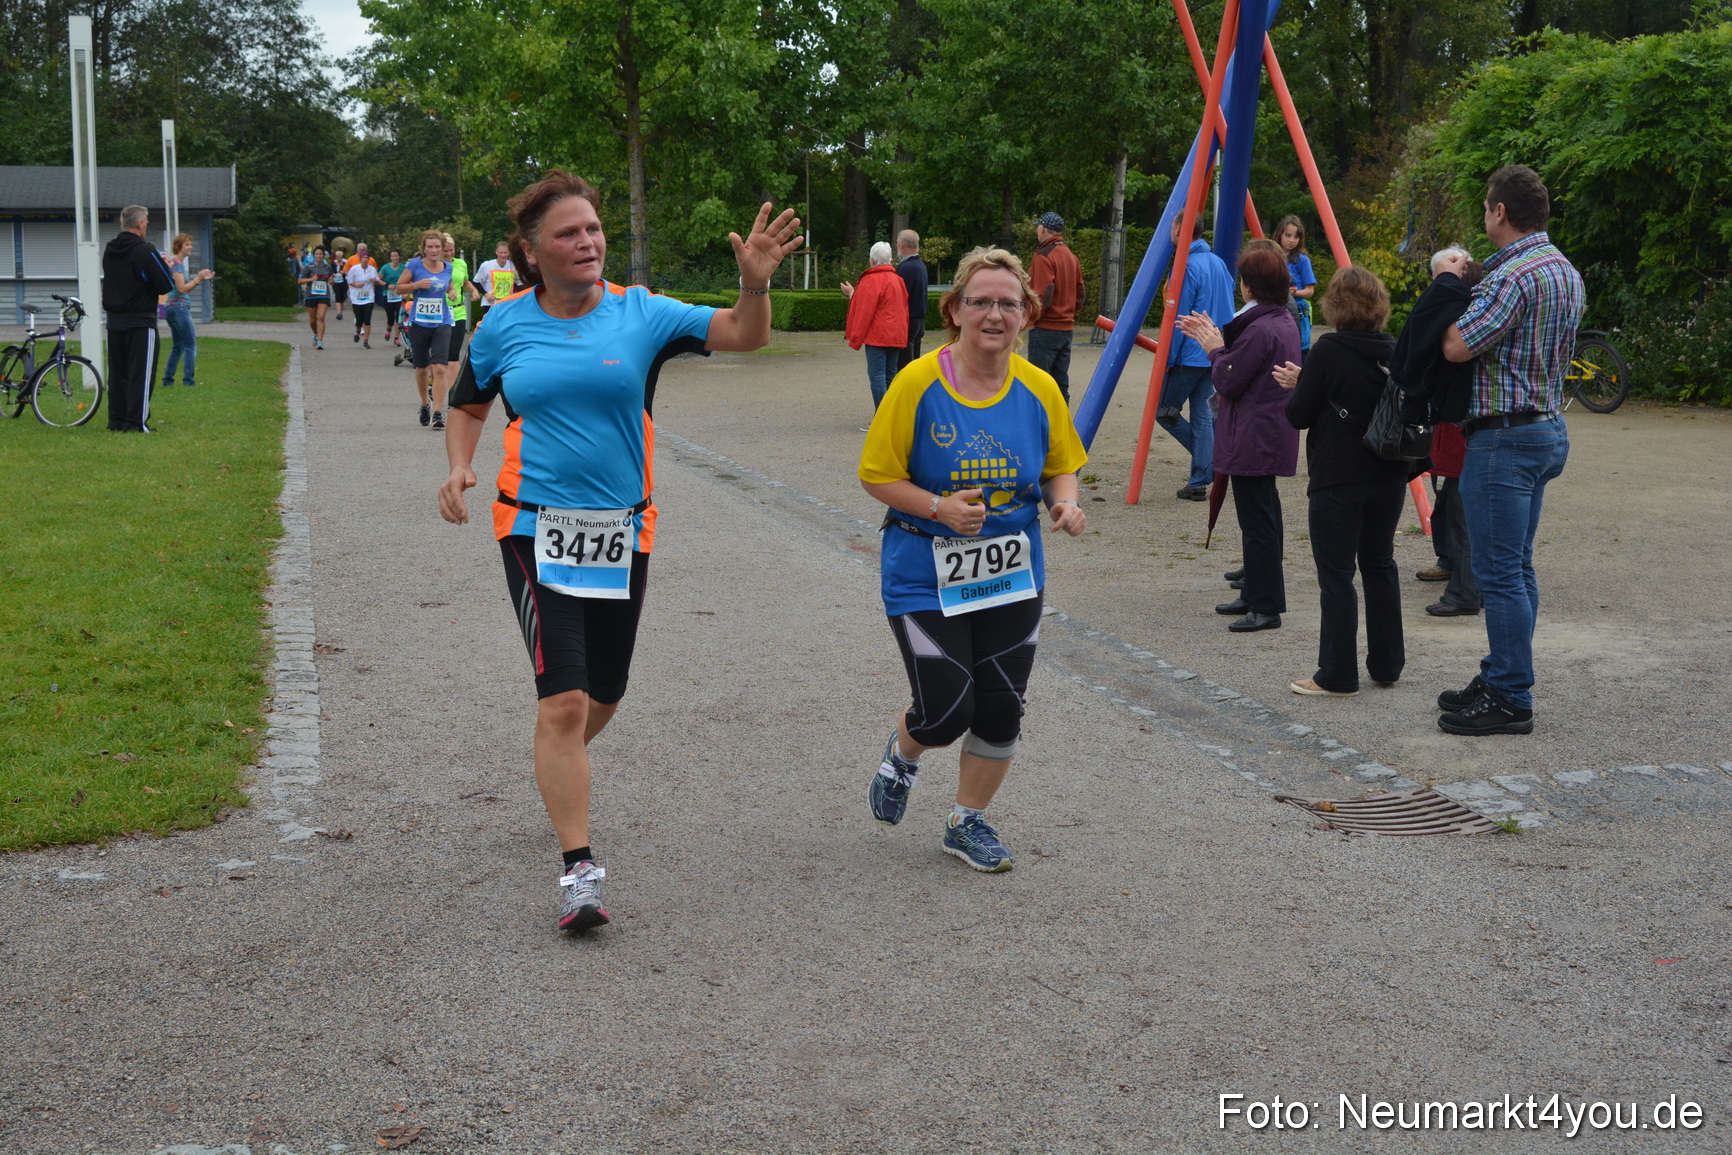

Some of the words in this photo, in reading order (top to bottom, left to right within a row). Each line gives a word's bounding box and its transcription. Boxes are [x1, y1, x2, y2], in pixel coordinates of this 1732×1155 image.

[418, 303, 441, 314] 2124
[540, 512, 573, 526] PARTL
[576, 518, 620, 528] Neumarkt
[545, 528, 625, 565] 3416
[945, 539, 1022, 583] 2792
[961, 580, 1012, 600] Gabriele
